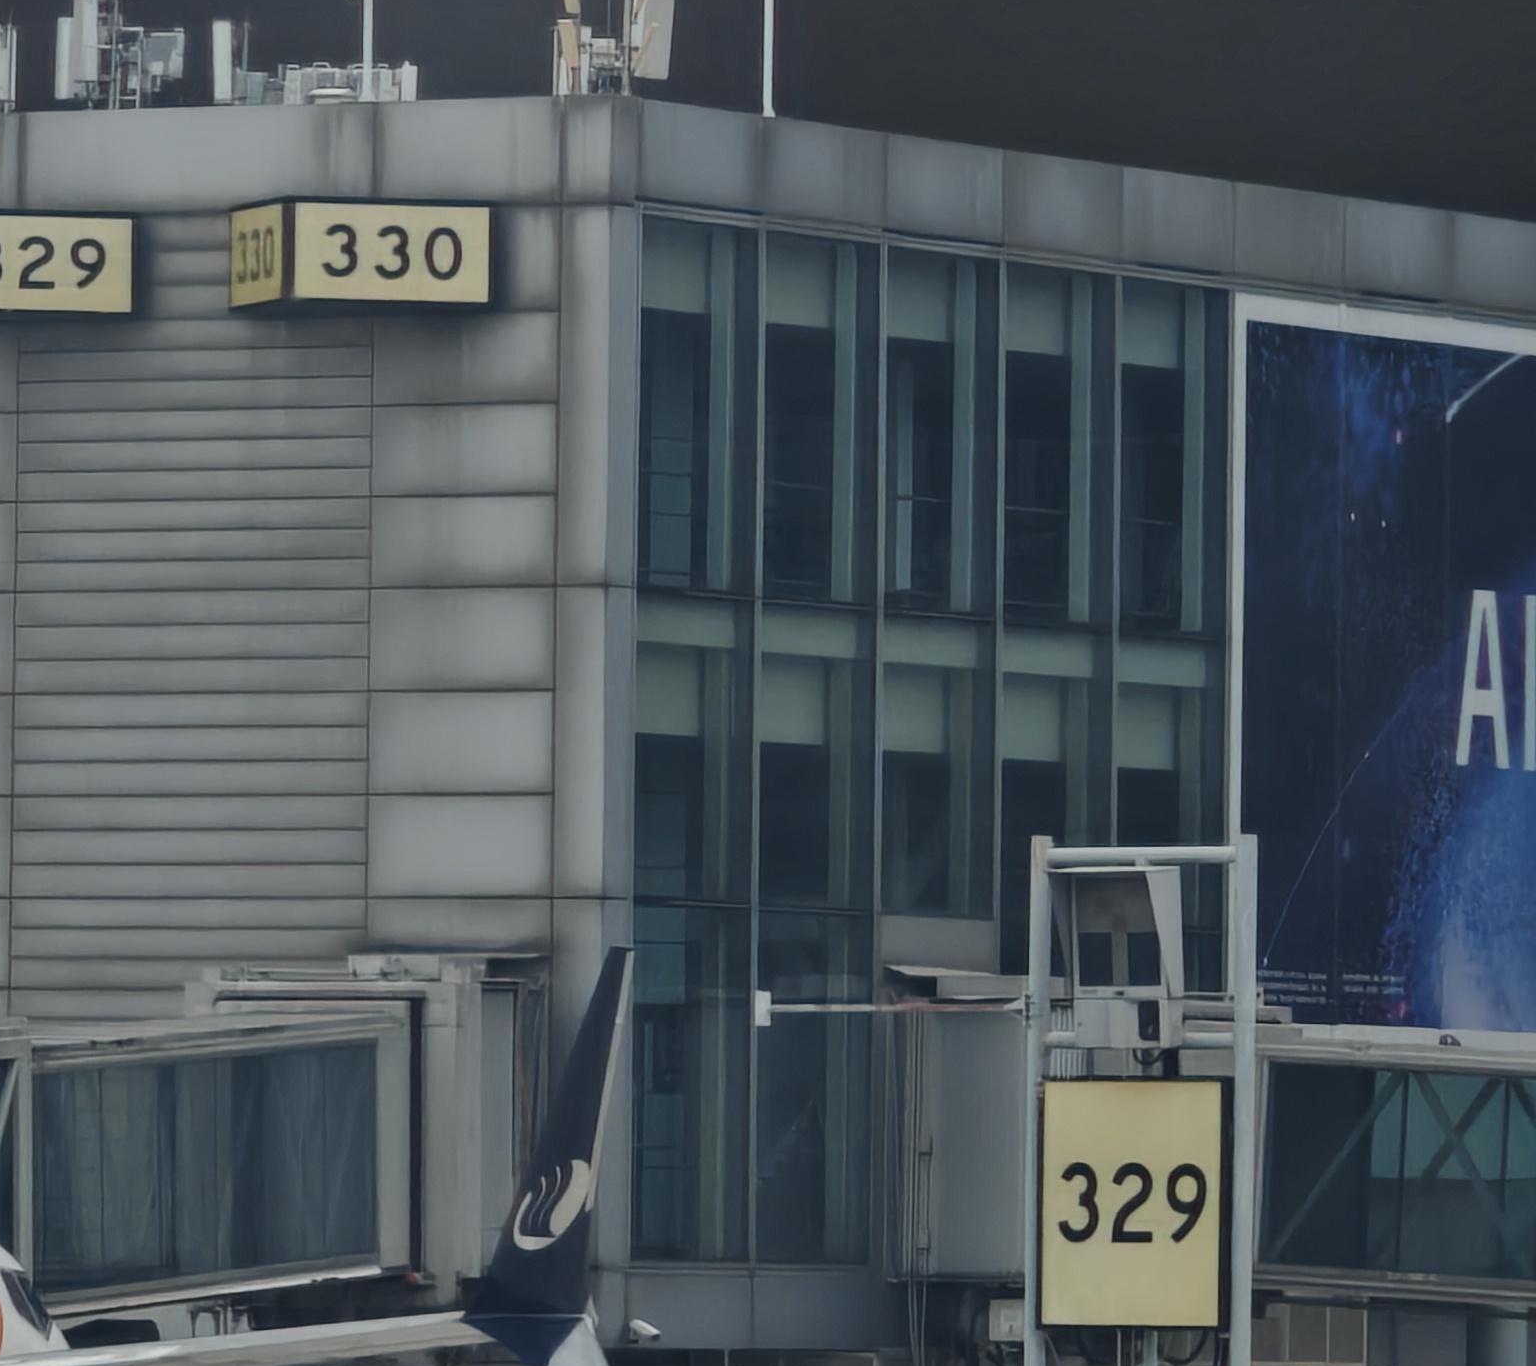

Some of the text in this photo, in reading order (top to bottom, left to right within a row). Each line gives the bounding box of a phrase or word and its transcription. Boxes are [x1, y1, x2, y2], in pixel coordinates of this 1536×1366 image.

[236, 225, 275, 283] 330
[321, 223, 463, 280] 330
[1058, 1161, 1207, 1243] 329
